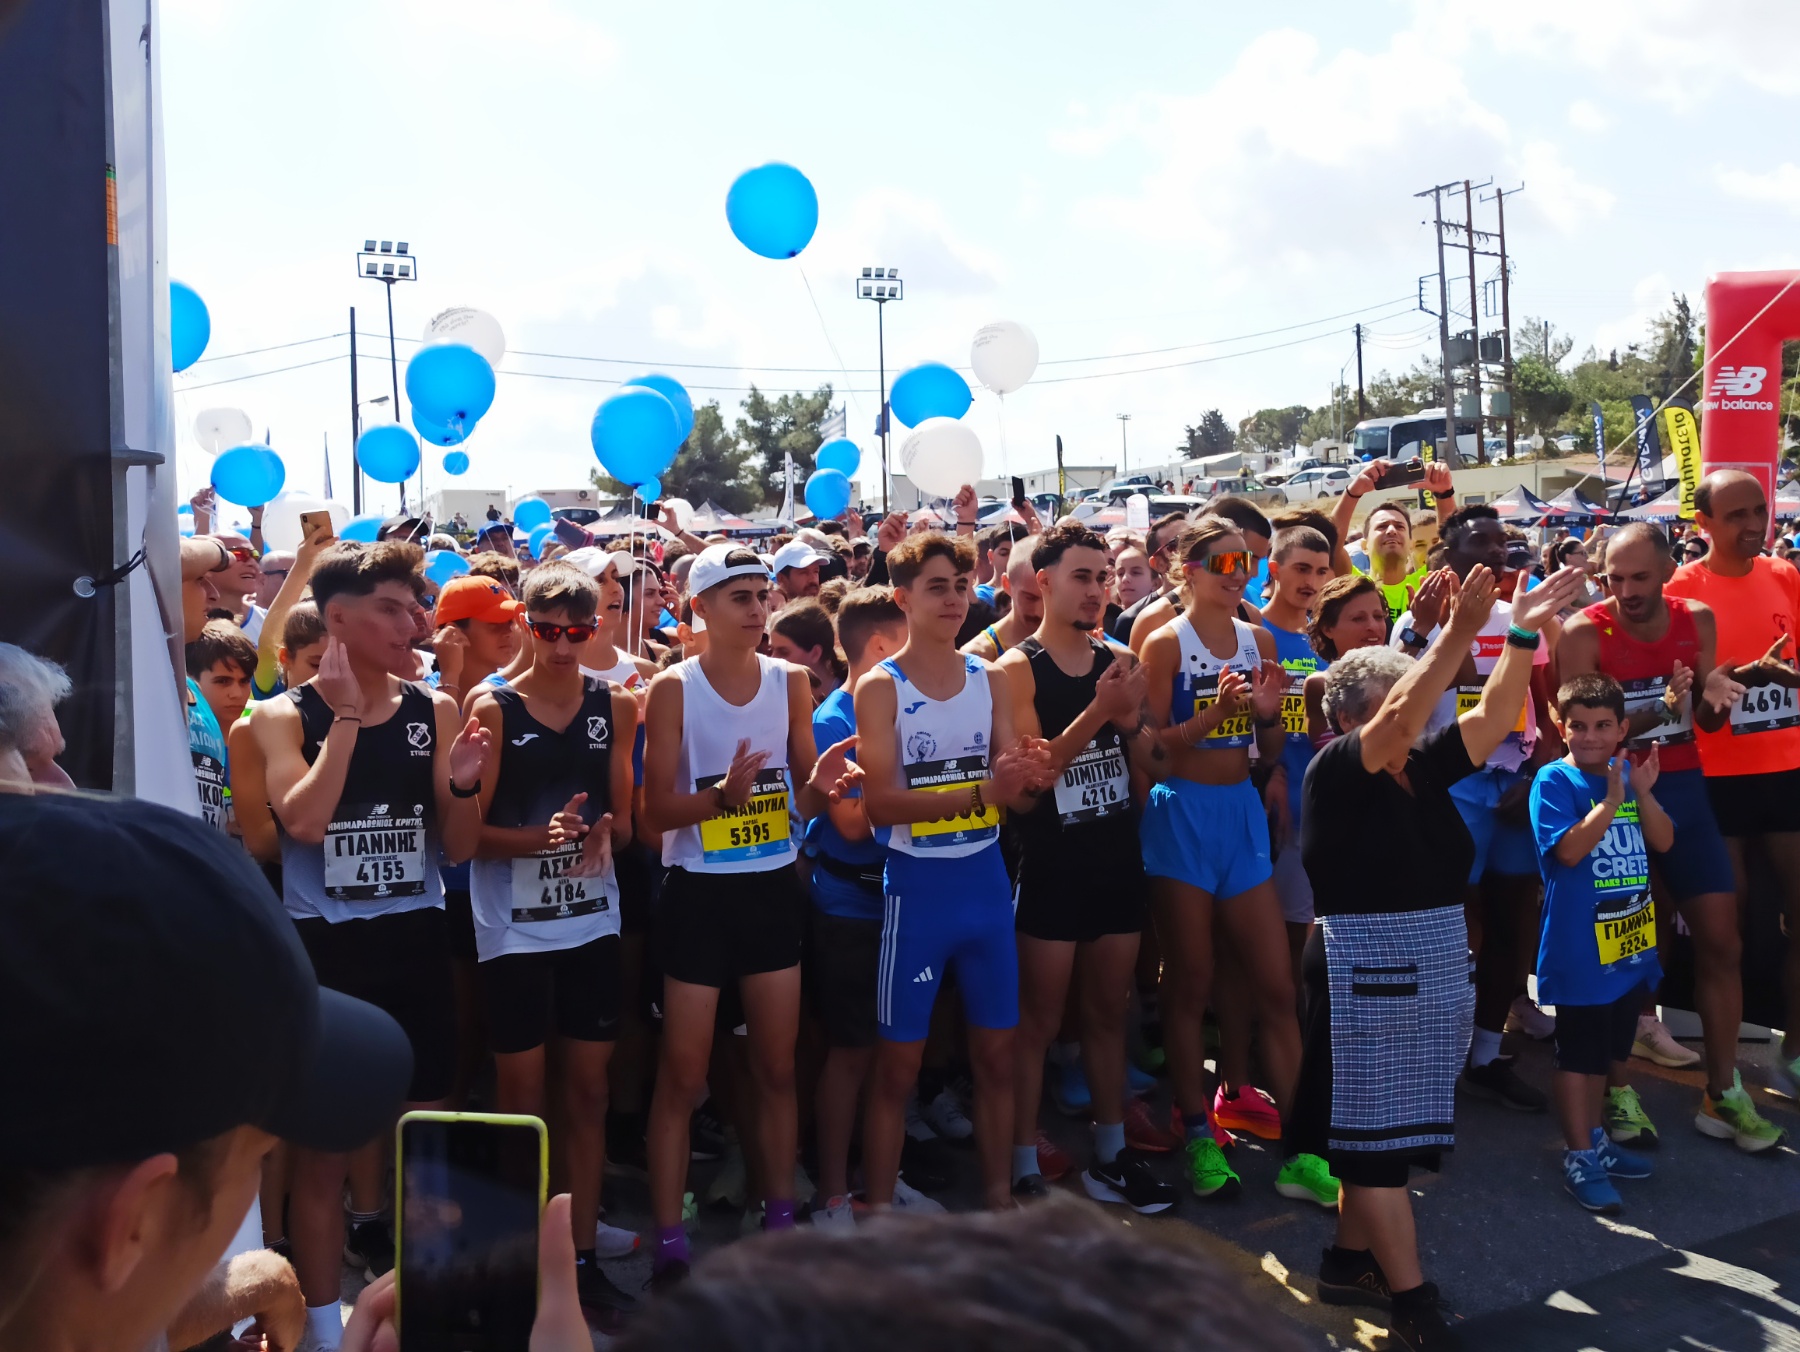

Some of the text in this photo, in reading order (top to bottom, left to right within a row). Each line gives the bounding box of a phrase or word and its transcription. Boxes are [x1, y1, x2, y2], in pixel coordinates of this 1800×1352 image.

[1721, 399, 1774, 410] balance
[1460, 699, 1480, 708] AND
[1741, 687, 1792, 714] 4694
[1281, 717, 1305, 733] 517
[910, 772, 966, 786] ΗΜΙΜΑΡΑΘΩΝΙΟΣ
[1063, 758, 1123, 788] DIMITRIS
[1081, 785, 1117, 807] 4216
[706, 796, 786, 821] ΜΑΝΟΥΗΛ
[327, 818, 423, 832] ΗΜΙΜΑΡΑΘΩΝΙΟΣ ΚΡΗΤΗΣ
[730, 822, 770, 846] 5395
[334, 831, 417, 858] ΓΙΑΝΝΗΣ
[1590, 825, 1647, 858] RUN
[356, 860, 405, 883] 4155
[1591, 854, 1649, 878] CRETE
[540, 882, 586, 905] 4184
[1619, 933, 1649, 957] 5224
